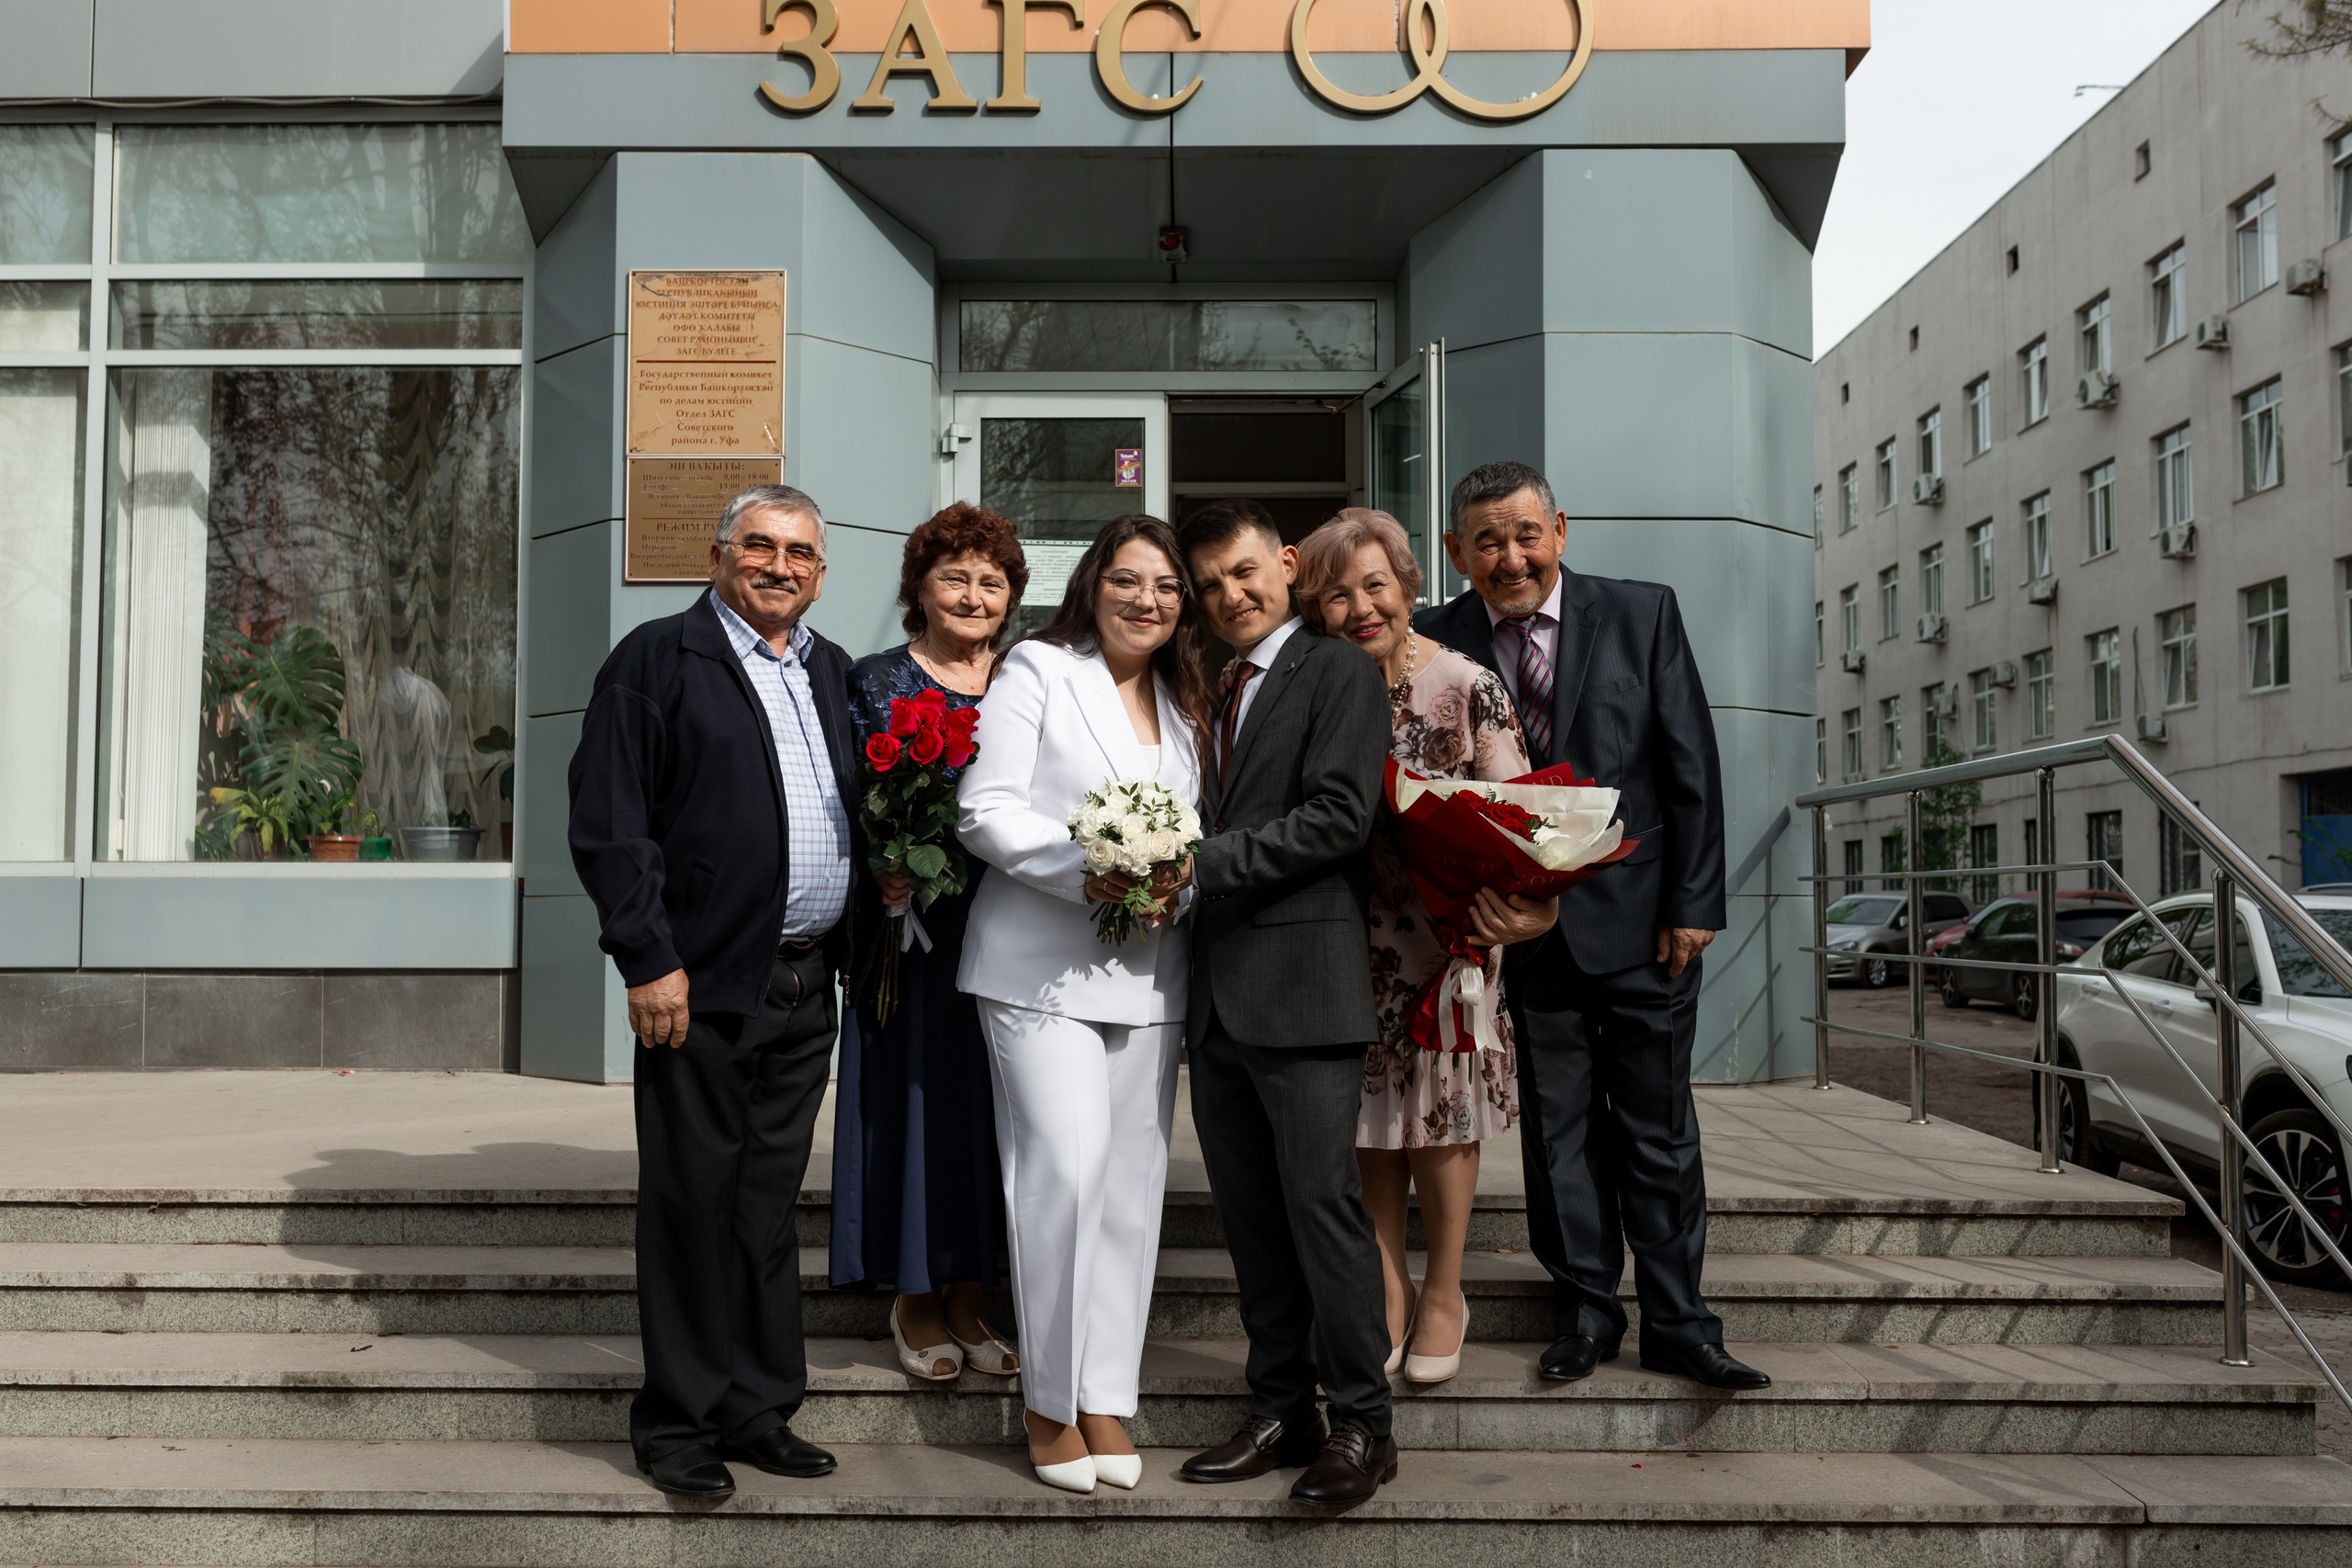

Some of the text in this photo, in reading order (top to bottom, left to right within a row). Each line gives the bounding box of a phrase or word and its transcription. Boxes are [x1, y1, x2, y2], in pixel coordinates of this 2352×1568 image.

[759, 0, 1204, 113] ЗАГС
[700, 312, 755, 321] КОМИТЕТЫ
[639, 369, 728, 379] Государственный
[639, 383, 774, 393] Республики Башкортостан
[675, 410, 736, 418] Отдел ЗАГС
[677, 423, 734, 431] Советского
[671, 436, 707, 446] района
[719, 436, 740, 446] Уфа
[666, 462, 685, 470] ЭШ
[656, 523, 700, 532] РЕЖИМ
[682, 535, 712, 543] суббота
[641, 544, 677, 552] Перерыв
